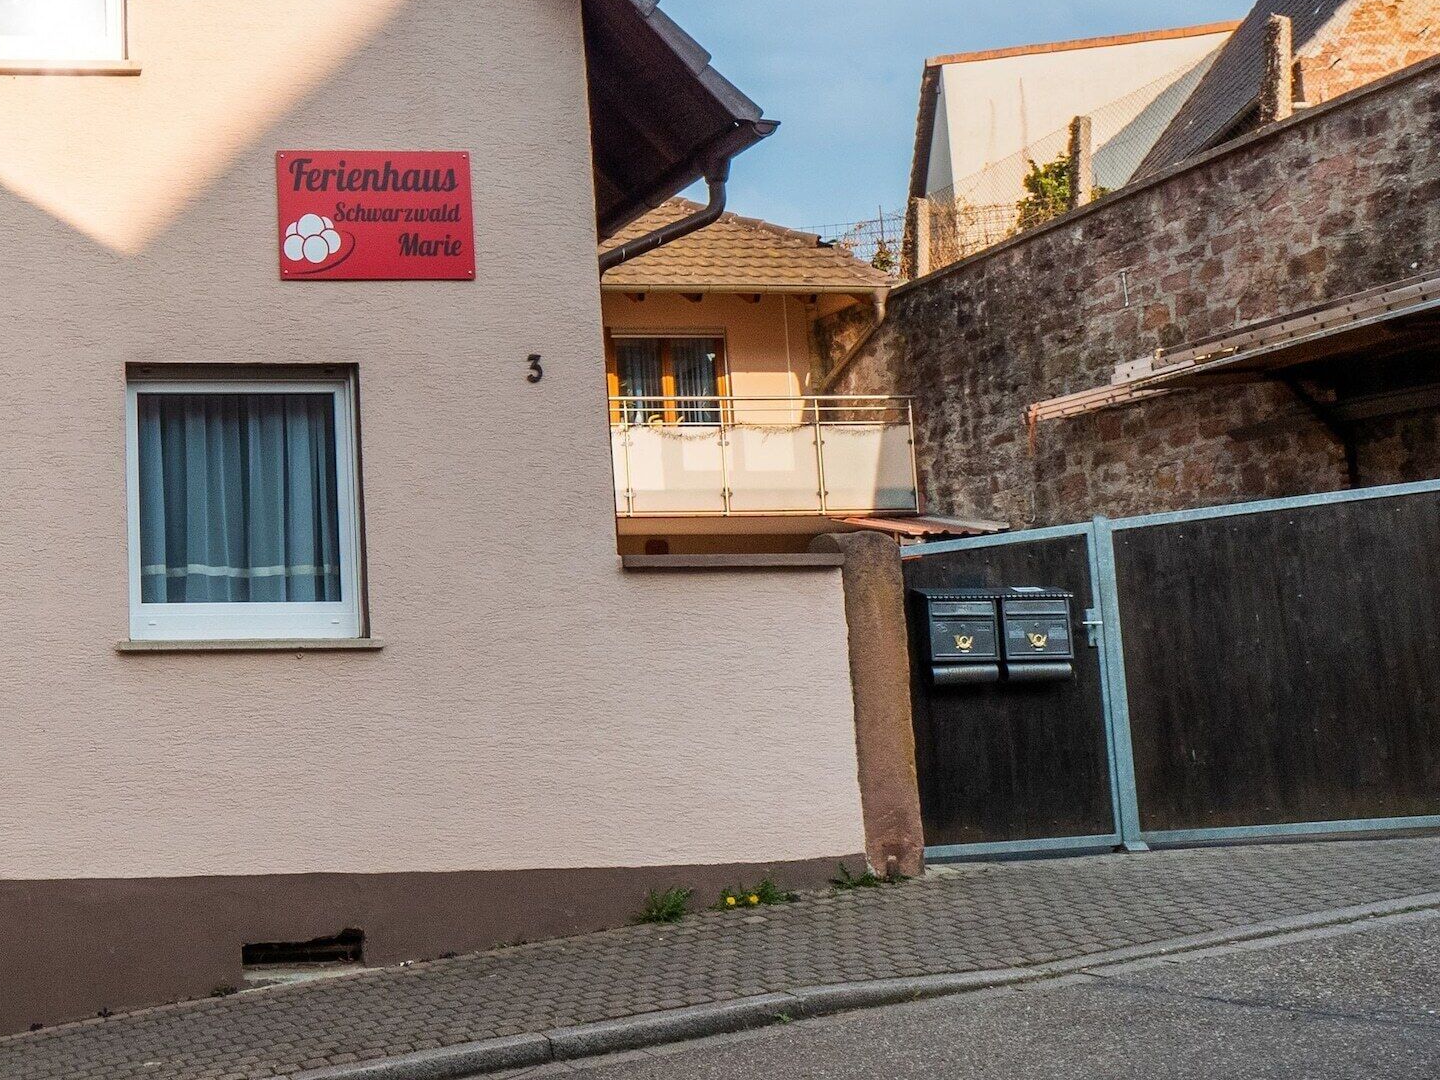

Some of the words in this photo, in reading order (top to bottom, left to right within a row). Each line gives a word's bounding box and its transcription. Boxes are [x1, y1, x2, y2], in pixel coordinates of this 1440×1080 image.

[289, 158, 458, 192] Ferienhaus
[333, 202, 460, 223] Schwarzwald
[398, 233, 462, 257] Marie
[527, 354, 543, 383] 3
